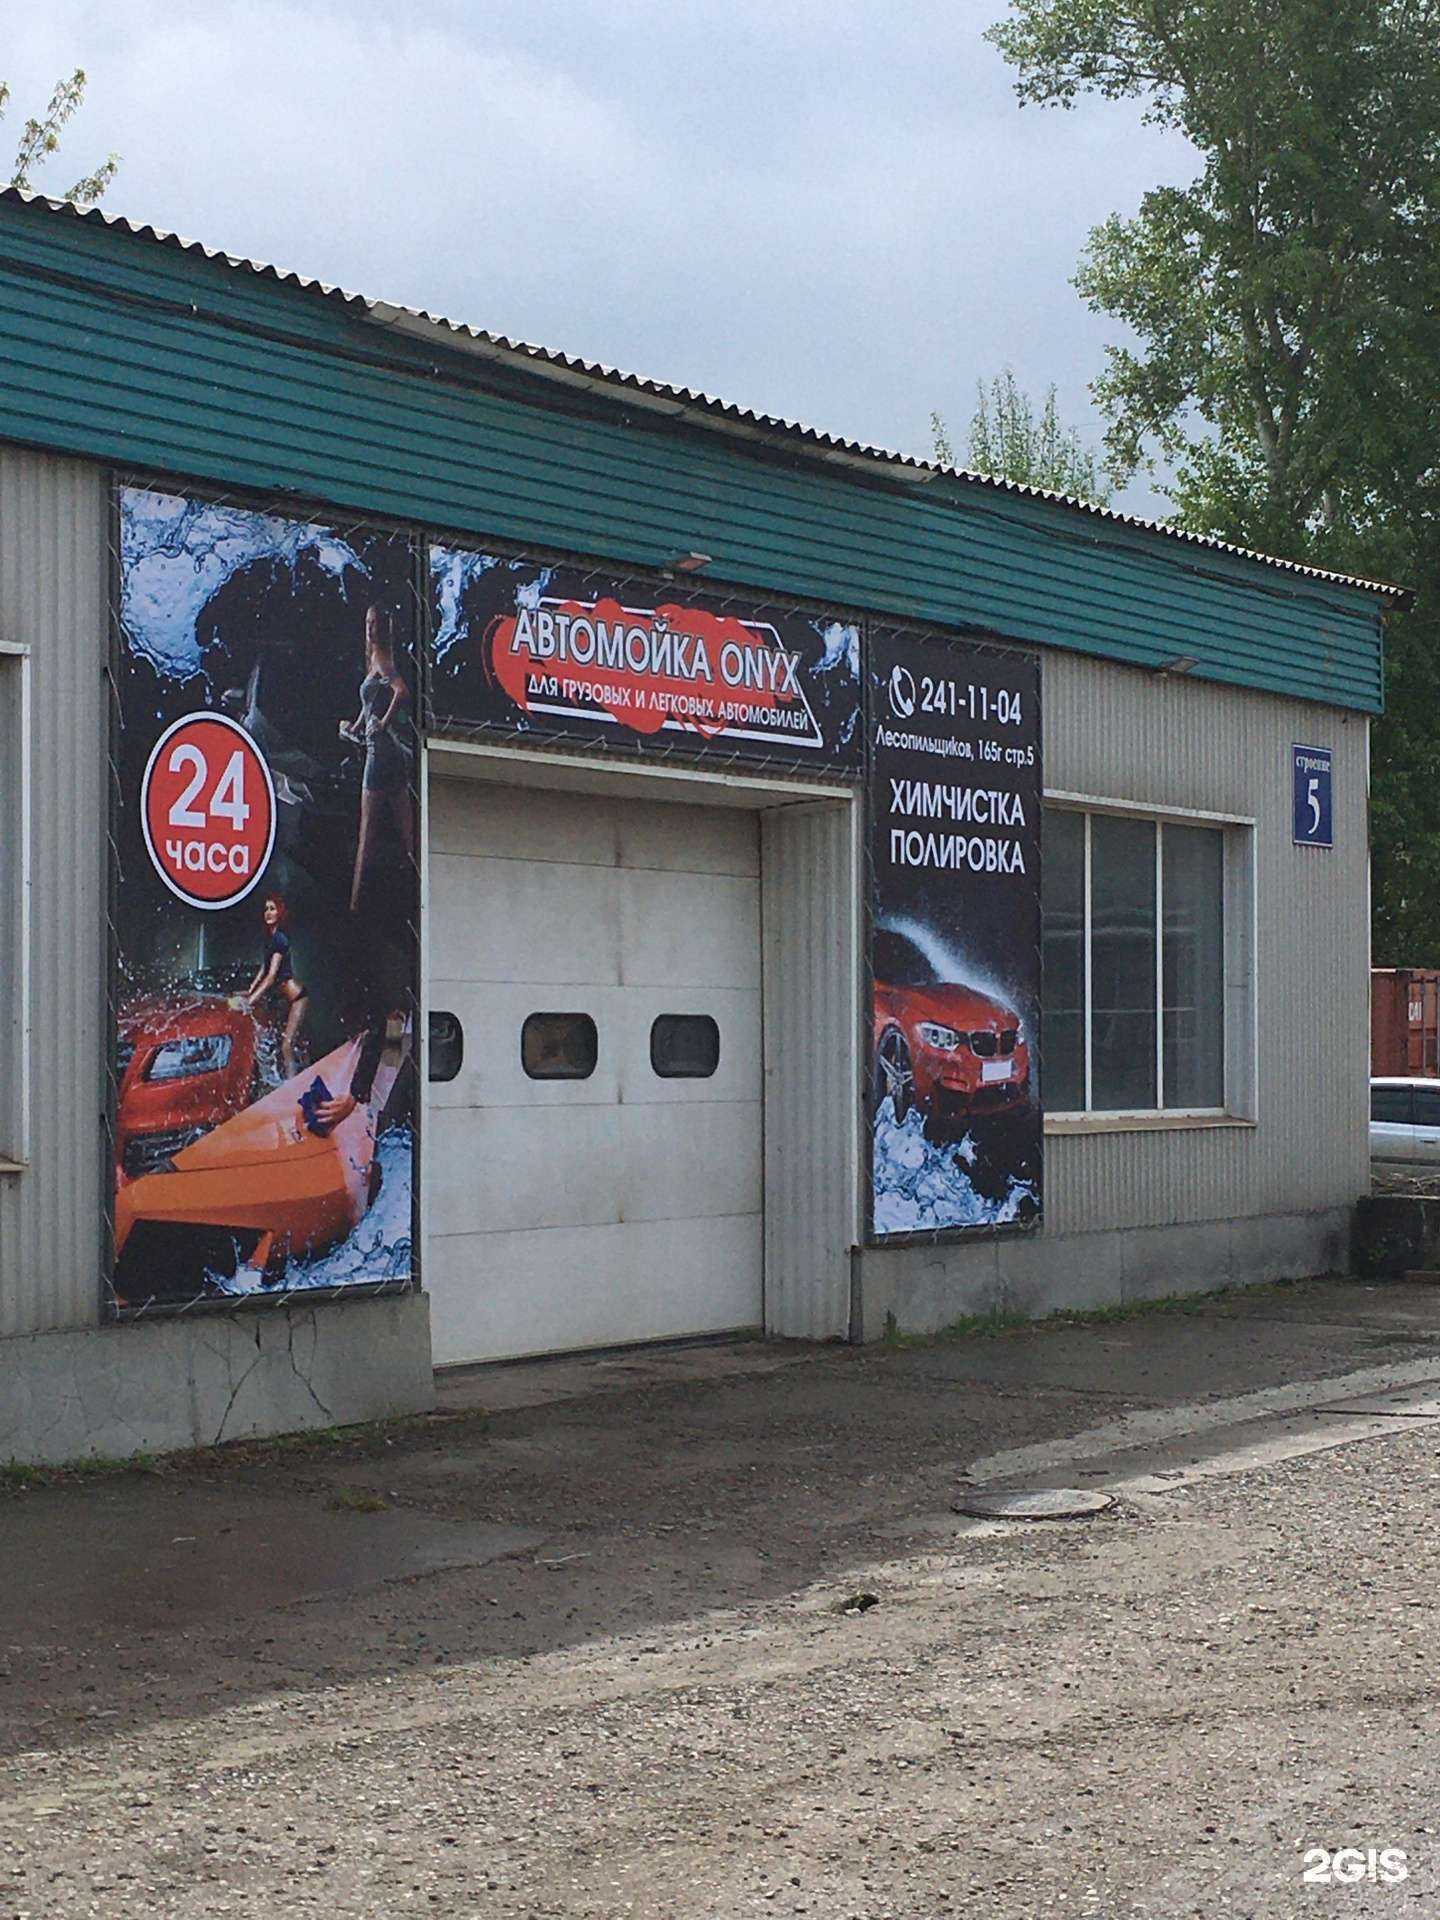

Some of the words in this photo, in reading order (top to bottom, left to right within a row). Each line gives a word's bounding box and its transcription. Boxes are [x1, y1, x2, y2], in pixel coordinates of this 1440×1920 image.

[511, 612, 711, 682] АВТОМОЙКА
[721, 645, 801, 694] ONYX
[528, 674, 558, 697] ДЛЯ
[562, 679, 631, 708] ГРУЗОВЫХ
[635, 690, 645, 709] И
[649, 691, 714, 718] ЛЕГКОВЫХ
[717, 702, 808, 730] АВТОМОБИЛЕЙ
[920, 676, 1022, 725] 241-11-04
[875, 724, 974, 761] Лесопильщиков,
[1005, 746, 1035, 768] стр.5
[168, 743, 250, 831] 24
[889, 778, 1026, 827] ХИМЧИСТКА
[1307, 778, 1320, 835] 5
[165, 839, 249, 874] часа
[890, 828, 1026, 874] ПОЛИРОВКА
